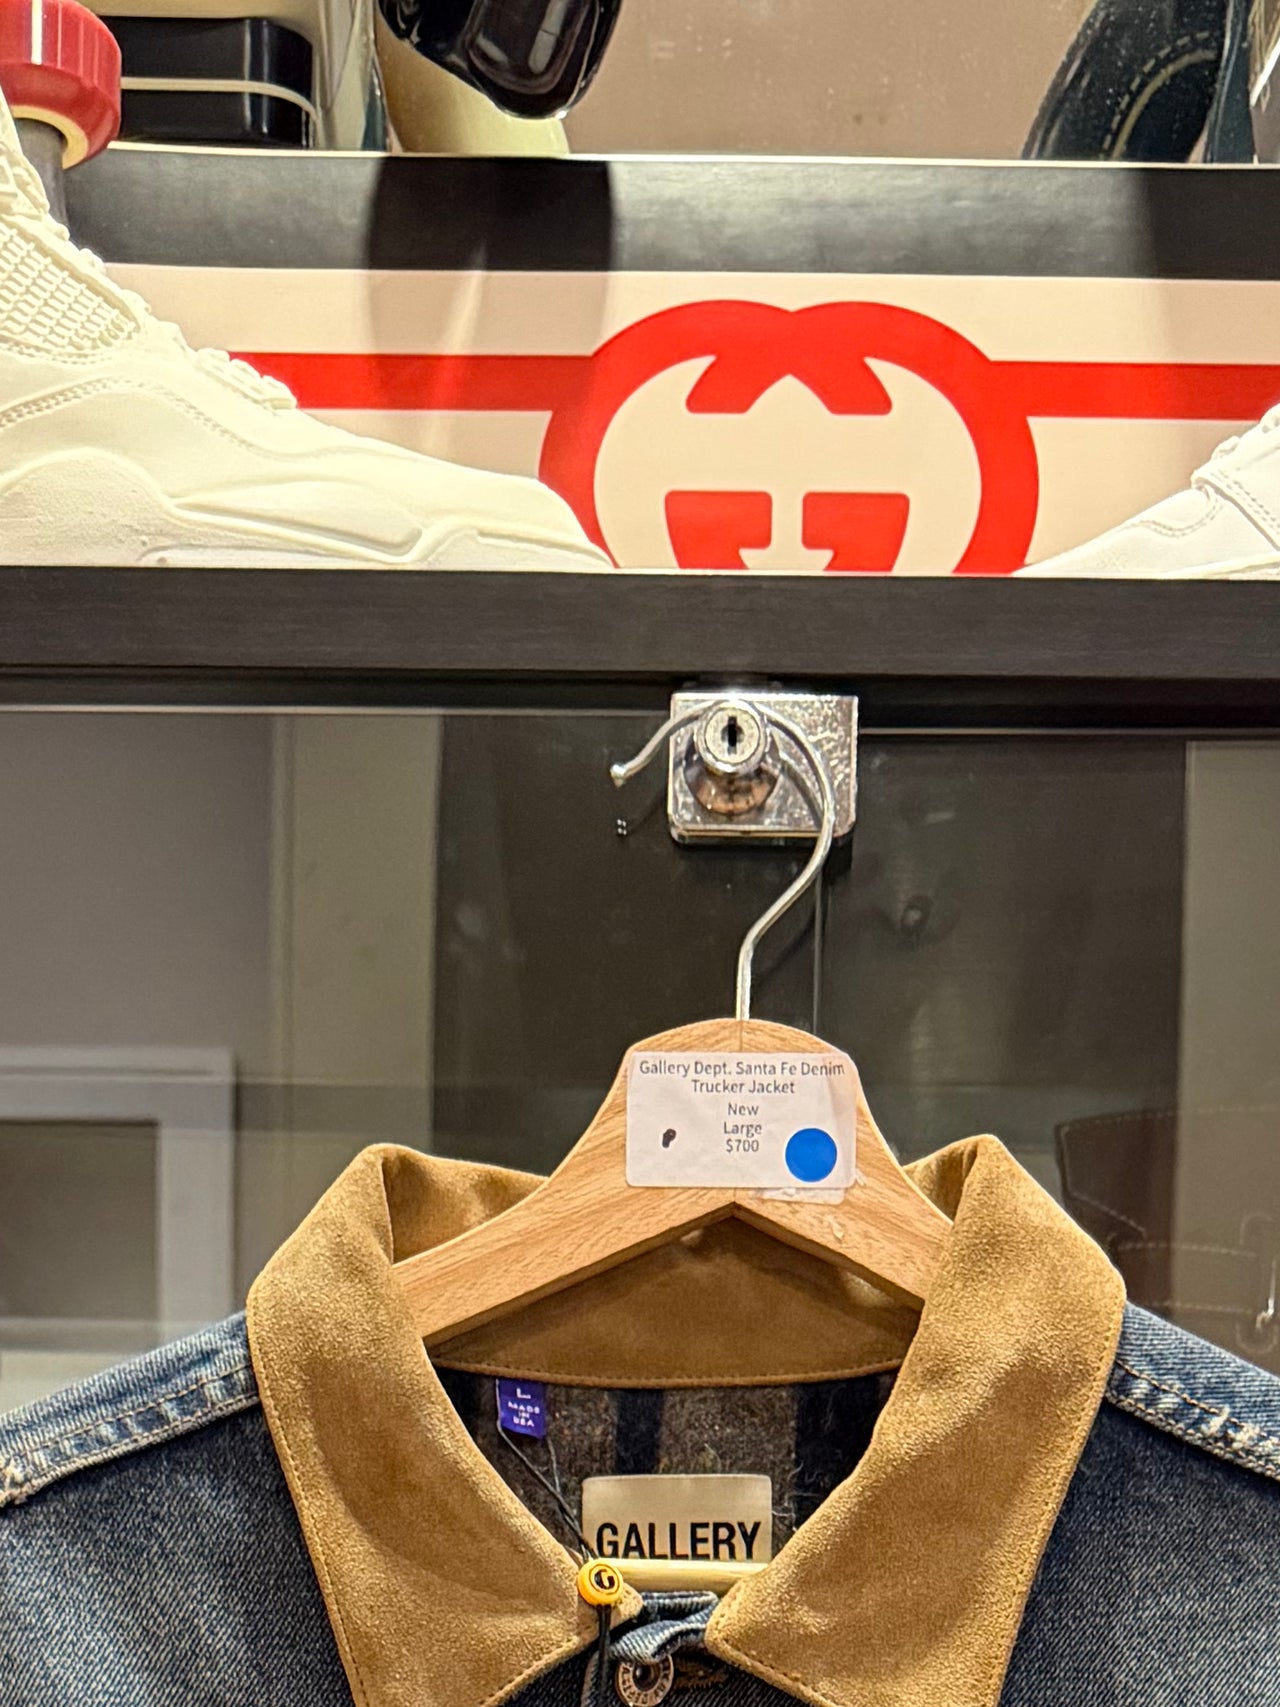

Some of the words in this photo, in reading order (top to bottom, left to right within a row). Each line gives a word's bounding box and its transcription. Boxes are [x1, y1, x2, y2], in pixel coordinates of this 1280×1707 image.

[640, 1060, 690, 1078] Gallery
[694, 1061, 731, 1077] Dept.
[735, 1061, 776, 1076] Santa
[780, 1061, 798, 1076] Fe
[801, 1061, 845, 1076] Denim
[691, 1079, 744, 1094] Trucker
[748, 1079, 795, 1094] Jacket
[727, 1103, 760, 1116] New
[723, 1122, 762, 1138] Large
[726, 1139, 760, 1153] $700
[516, 1388, 531, 1399] L
[596, 1521, 761, 1560] GALLERY
